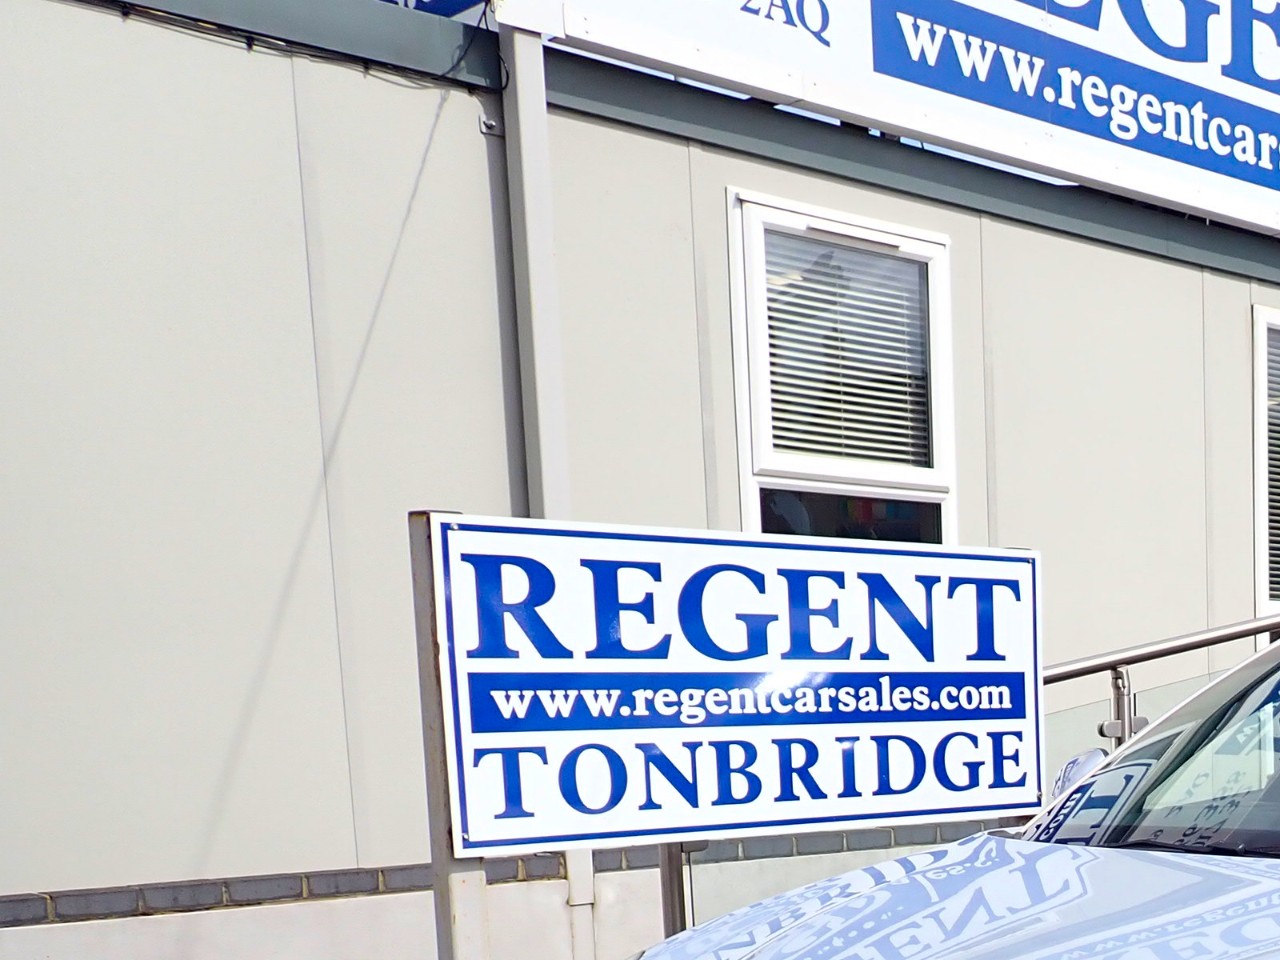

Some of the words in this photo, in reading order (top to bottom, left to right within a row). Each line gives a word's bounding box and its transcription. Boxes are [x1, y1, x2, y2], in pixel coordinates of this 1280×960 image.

[460, 552, 1021, 663] REGENT
[490, 676, 1013, 724] www.regentcarsales.com
[473, 730, 1027, 820] TONBRIDGE
